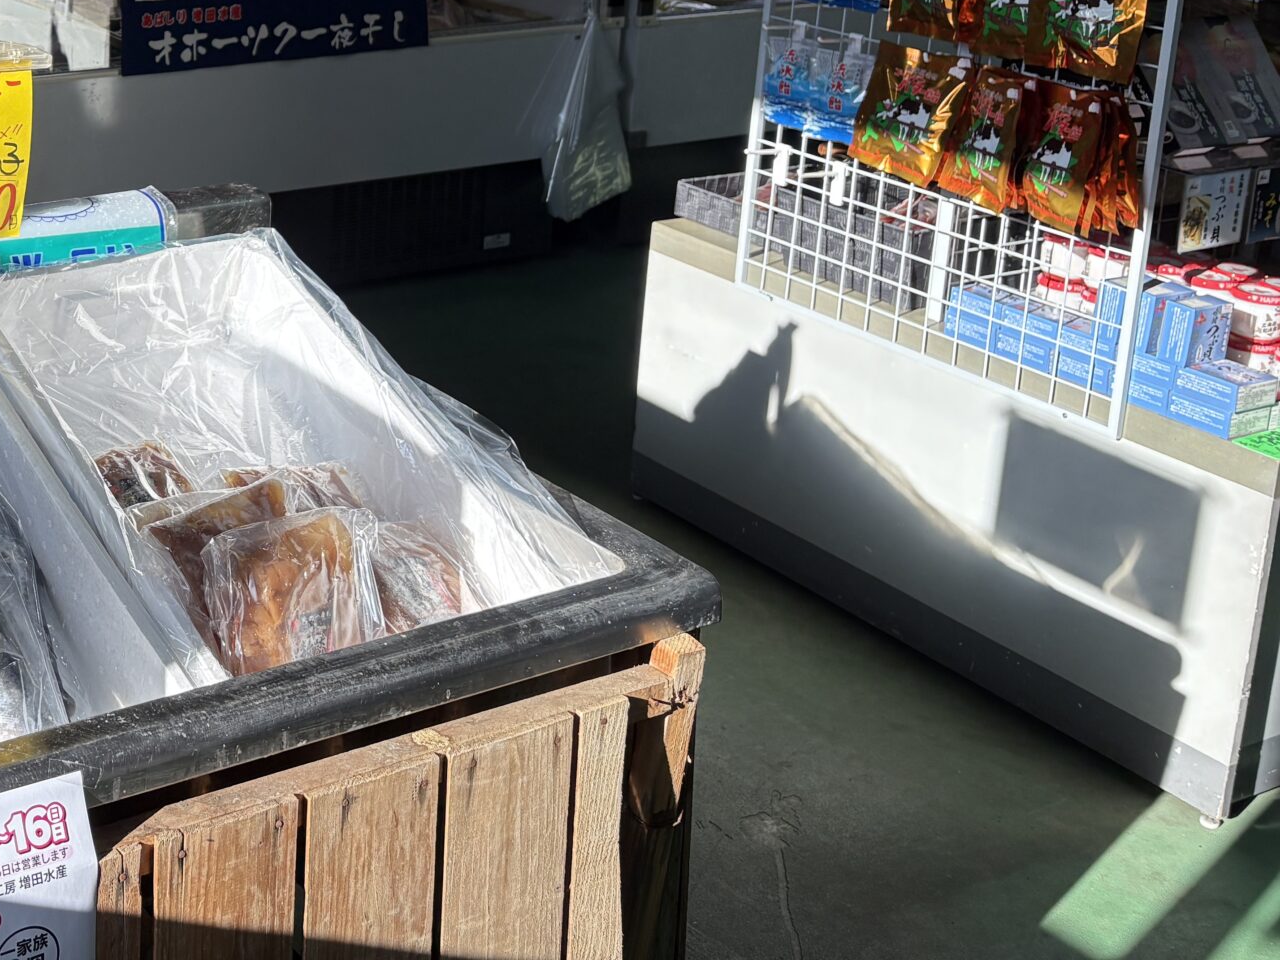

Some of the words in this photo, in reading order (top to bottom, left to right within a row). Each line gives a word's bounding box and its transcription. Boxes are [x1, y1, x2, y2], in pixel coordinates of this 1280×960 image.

[141, 13, 188, 29] あばしり
[191, 4, 244, 23] 増田水産
[148, 9, 407, 67] オホーツク一夜干し
[1210, 194, 1227, 244] つぶ貝
[19, 865, 69, 893] 増田水産
